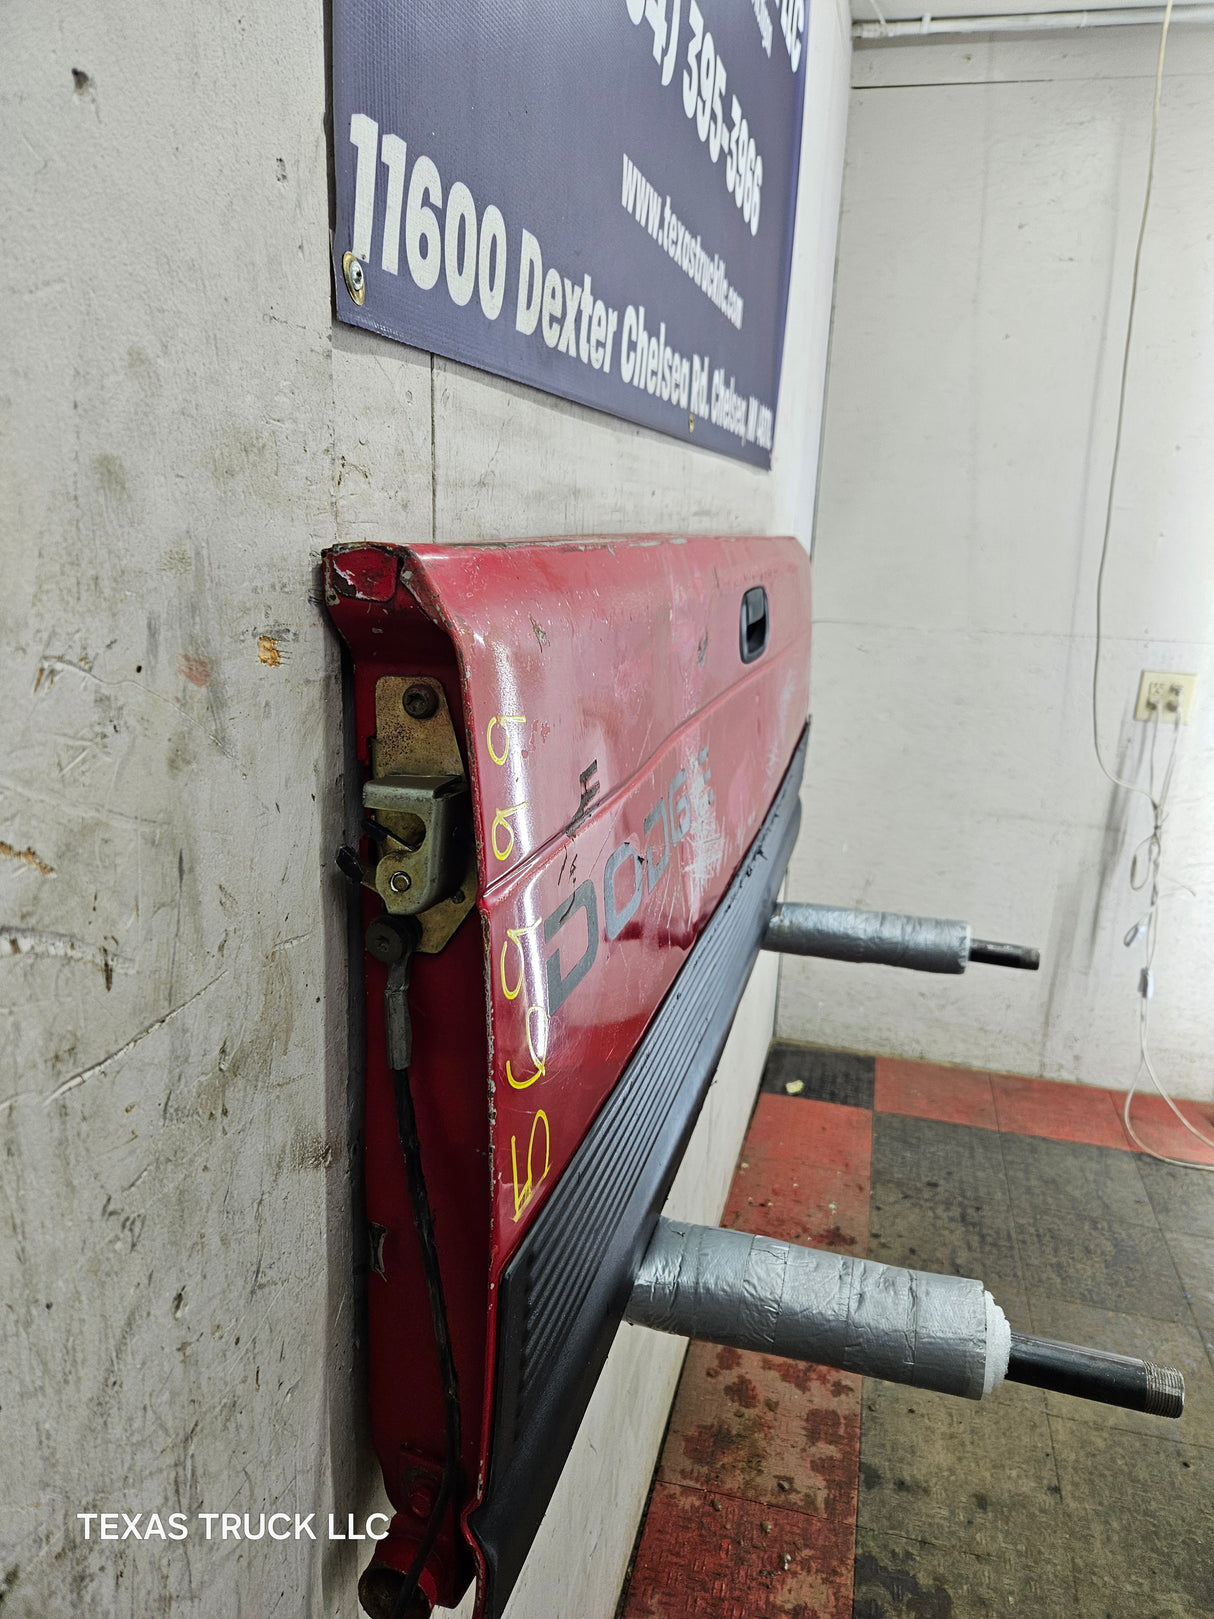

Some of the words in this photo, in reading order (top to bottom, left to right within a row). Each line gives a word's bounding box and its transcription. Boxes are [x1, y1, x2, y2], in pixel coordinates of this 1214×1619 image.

[683, 0, 763, 237] 395-3966
[349, 112, 507, 321] 11600
[515, 227, 618, 374] Dexter
[620, 304, 691, 410] Chelsea
[690, 353, 709, 421] Rd.
